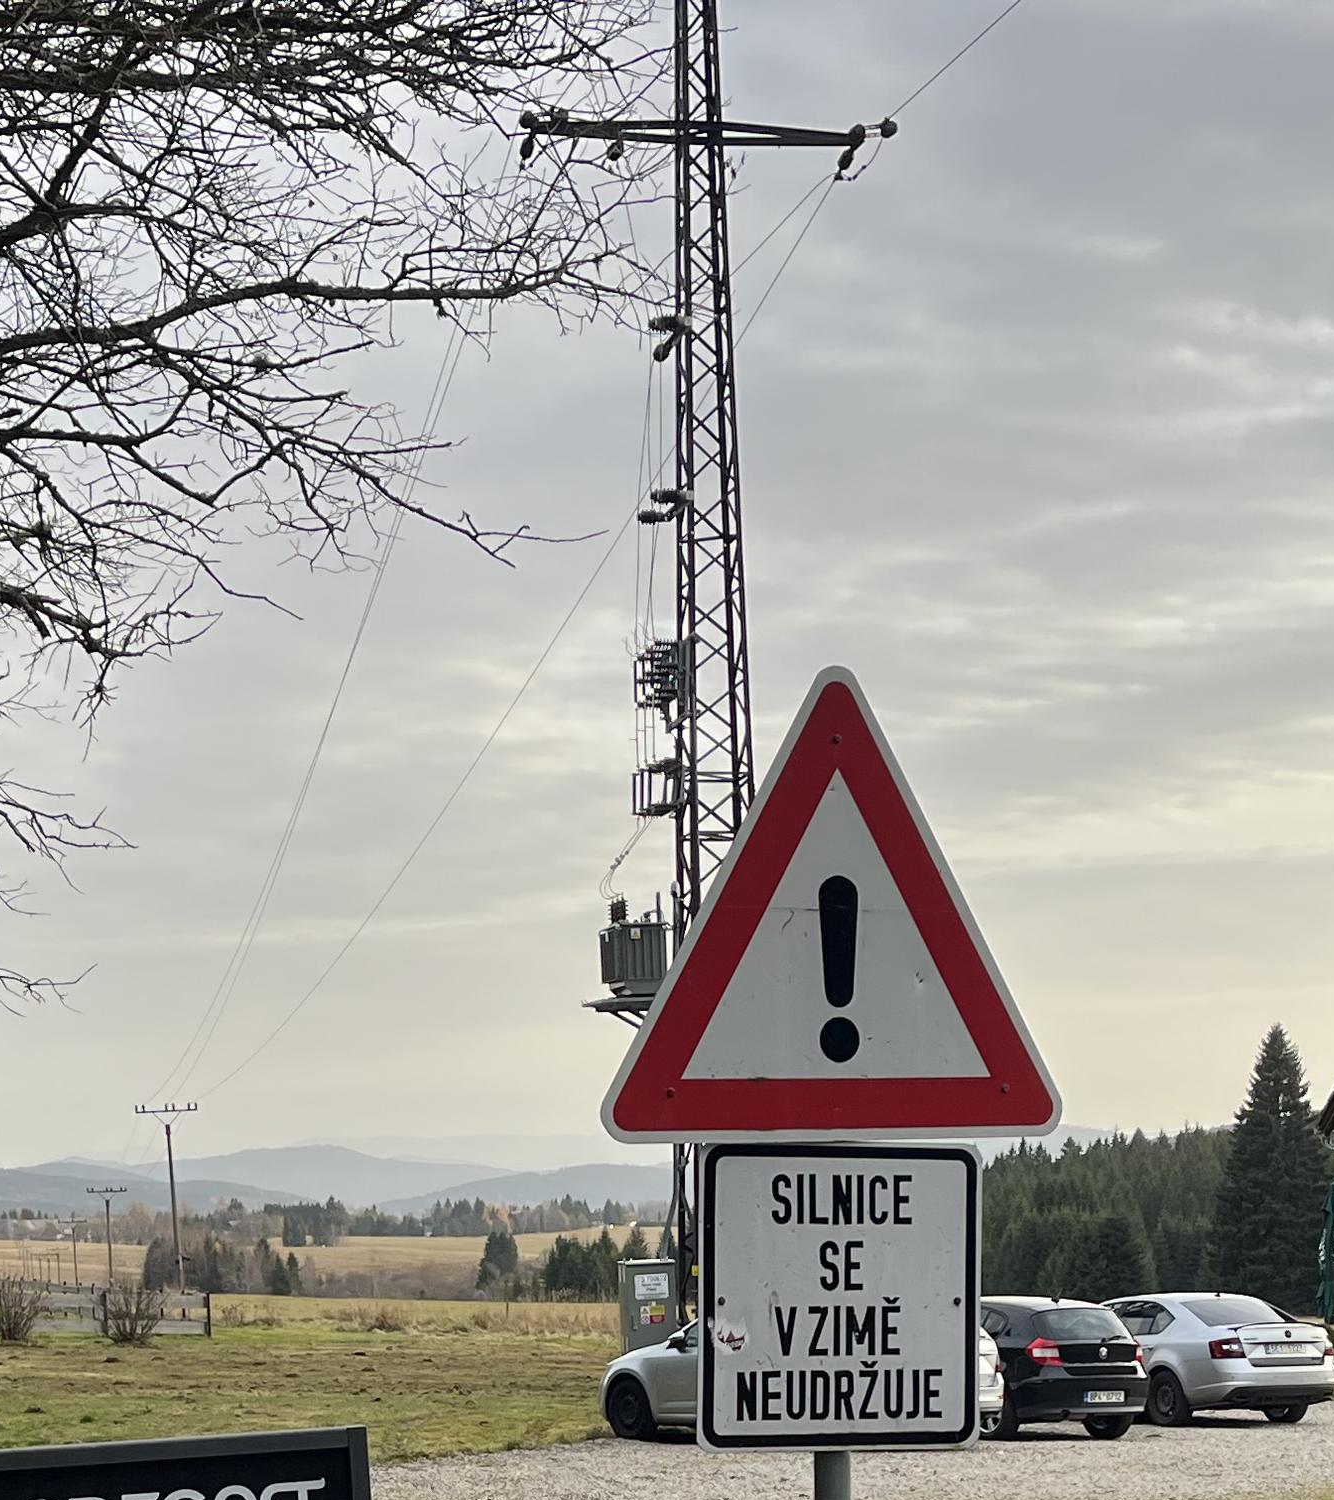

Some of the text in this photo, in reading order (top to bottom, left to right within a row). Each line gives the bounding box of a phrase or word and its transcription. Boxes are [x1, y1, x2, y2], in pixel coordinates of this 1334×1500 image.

[771, 1173, 913, 1225] SILNICE
[819, 1240, 864, 1291] SE
[774, 1306, 798, 1357] V
[808, 1296, 901, 1357] ZIMĚ
[736, 1360, 943, 1421] NEUDRŽUJE
